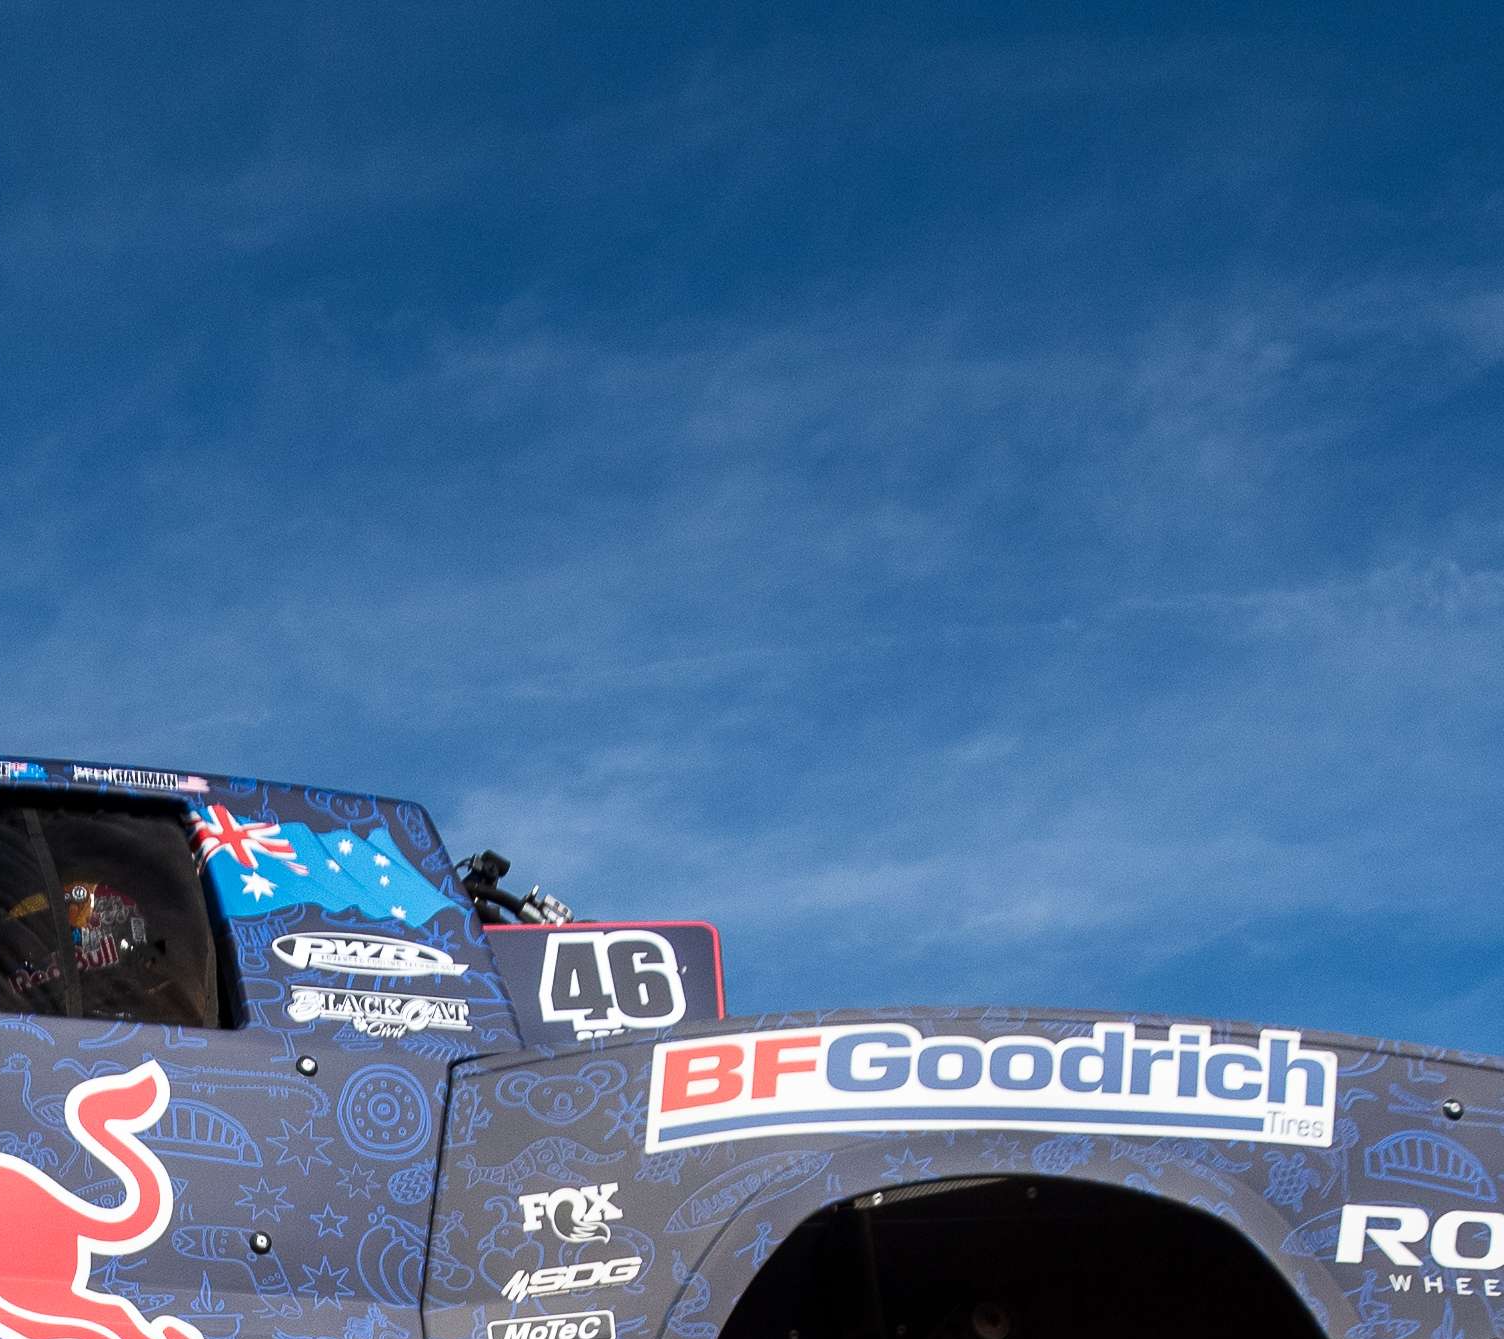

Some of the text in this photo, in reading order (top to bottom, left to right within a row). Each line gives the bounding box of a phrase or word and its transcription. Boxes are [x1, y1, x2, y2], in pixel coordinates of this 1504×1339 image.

[292, 936, 438, 969] PWR
[542, 932, 684, 1029] 46
[288, 990, 470, 1032] BLACK CAT
[659, 1031, 1325, 1113] BFGoodrich
[1266, 1110, 1324, 1139] Tires
[518, 1182, 624, 1245] FOX
